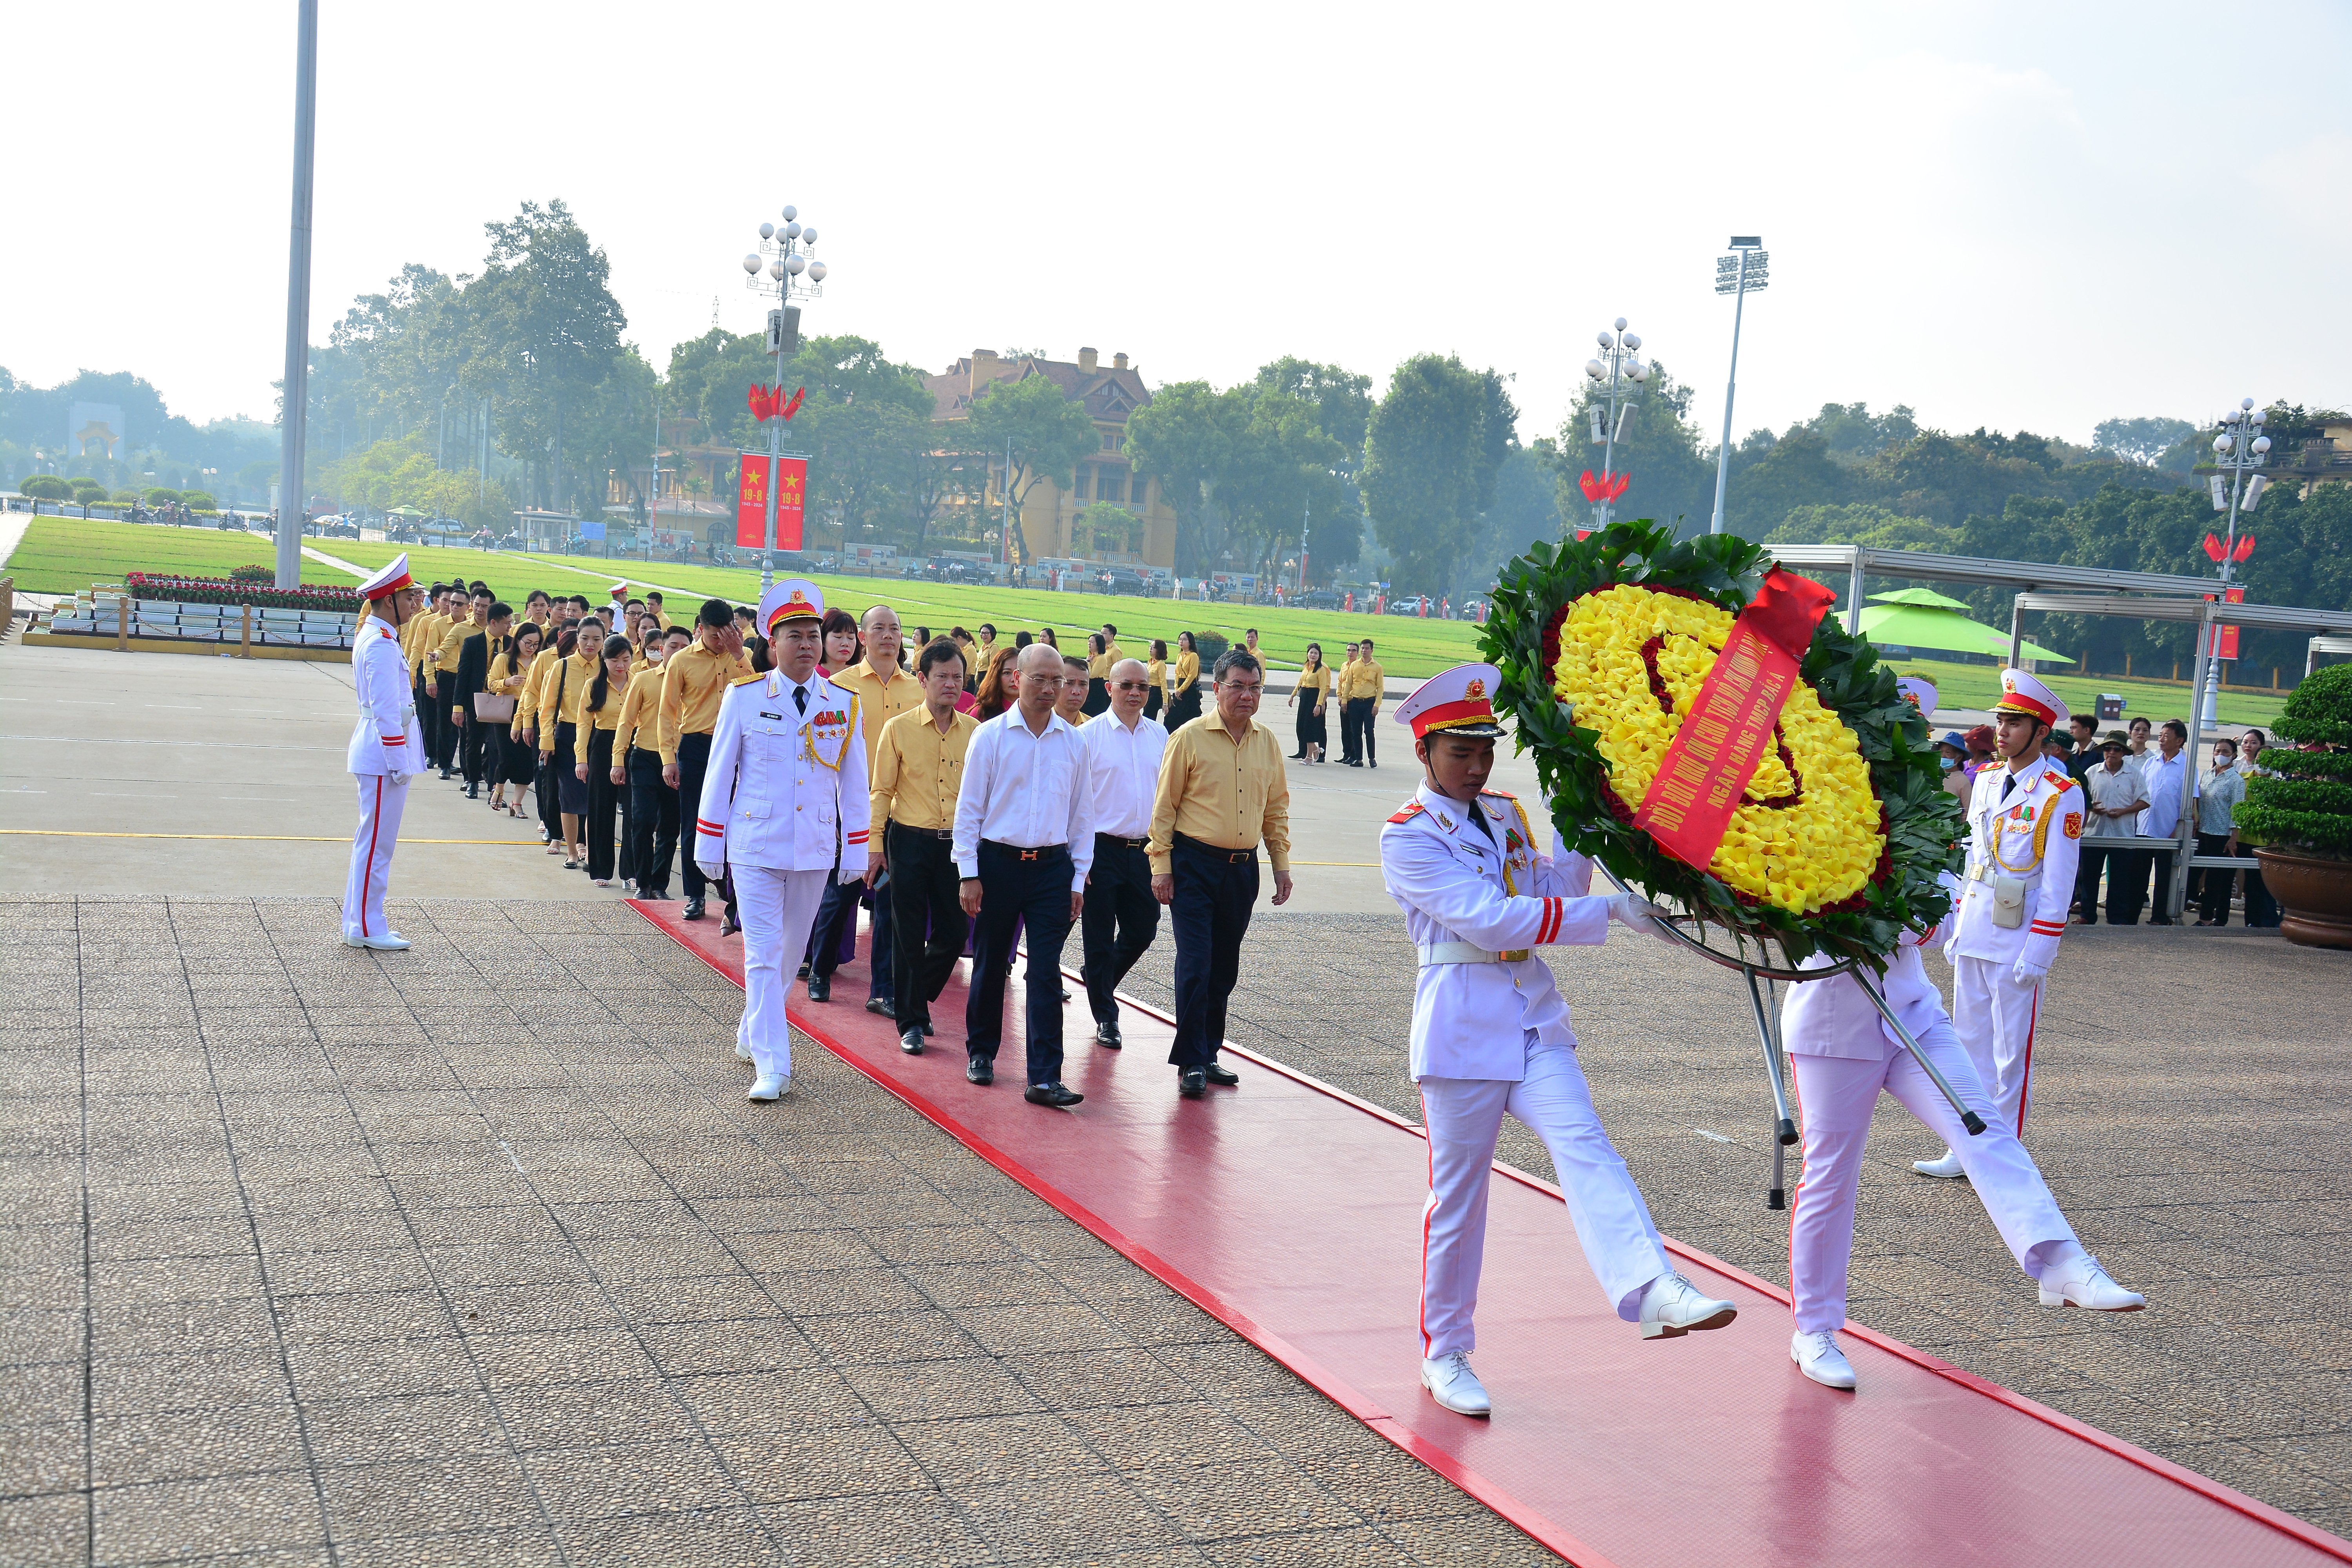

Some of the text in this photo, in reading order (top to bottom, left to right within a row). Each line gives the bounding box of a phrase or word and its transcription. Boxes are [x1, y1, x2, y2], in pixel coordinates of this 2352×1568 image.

[744, 488, 762, 501] 19-8
[782, 492, 800, 505] 19-8
[1721, 664, 1753, 692] CHÍ
[1729, 651, 1760, 679] MINH
[1711, 677, 1746, 705] HỒ
[1704, 693, 1740, 723] TỊCH
[1692, 713, 1730, 744] CHỦ
[1707, 670, 1785, 809] NGÂN HÀNG TMCP BẮC Á
[1683, 737, 1719, 761] ƠN
[1672, 751, 1710, 786] NHỚ
[1659, 778, 1697, 808] ĐỜI
[1646, 802, 1686, 832] ĐỜI
